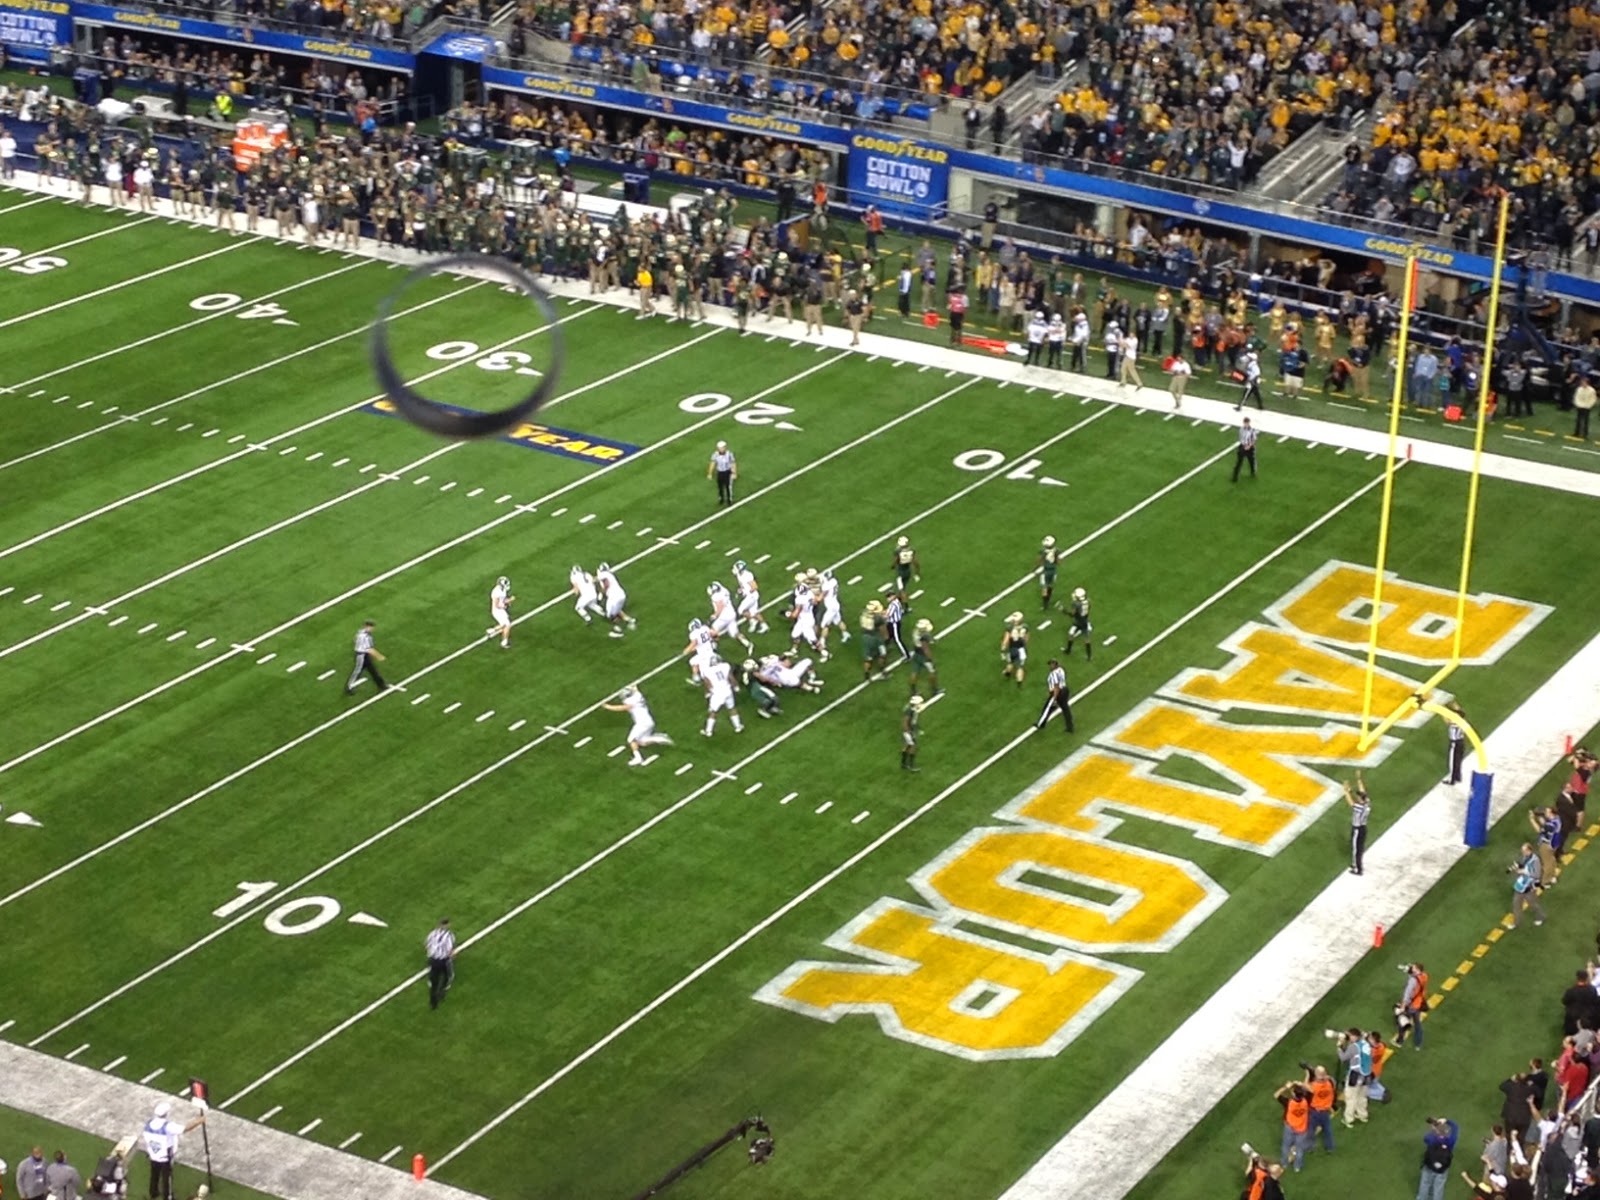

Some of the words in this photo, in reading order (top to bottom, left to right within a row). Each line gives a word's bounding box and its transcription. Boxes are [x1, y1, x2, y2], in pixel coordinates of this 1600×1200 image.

[727, 113, 801, 134] GOODYEAR
[852, 134, 948, 164] GOODYEAR
[866, 172, 914, 196] BOWL
[867, 156, 932, 183] COTTON
[1365, 238, 1454, 265] GOODYEAR
[189, 293, 288, 319] 40
[425, 341, 532, 371] 30
[679, 392, 795, 425] 20
[953, 449, 1042, 480] 10
[752, 560, 1556, 1062] BAYLOR
[212, 881, 341, 936] 10
